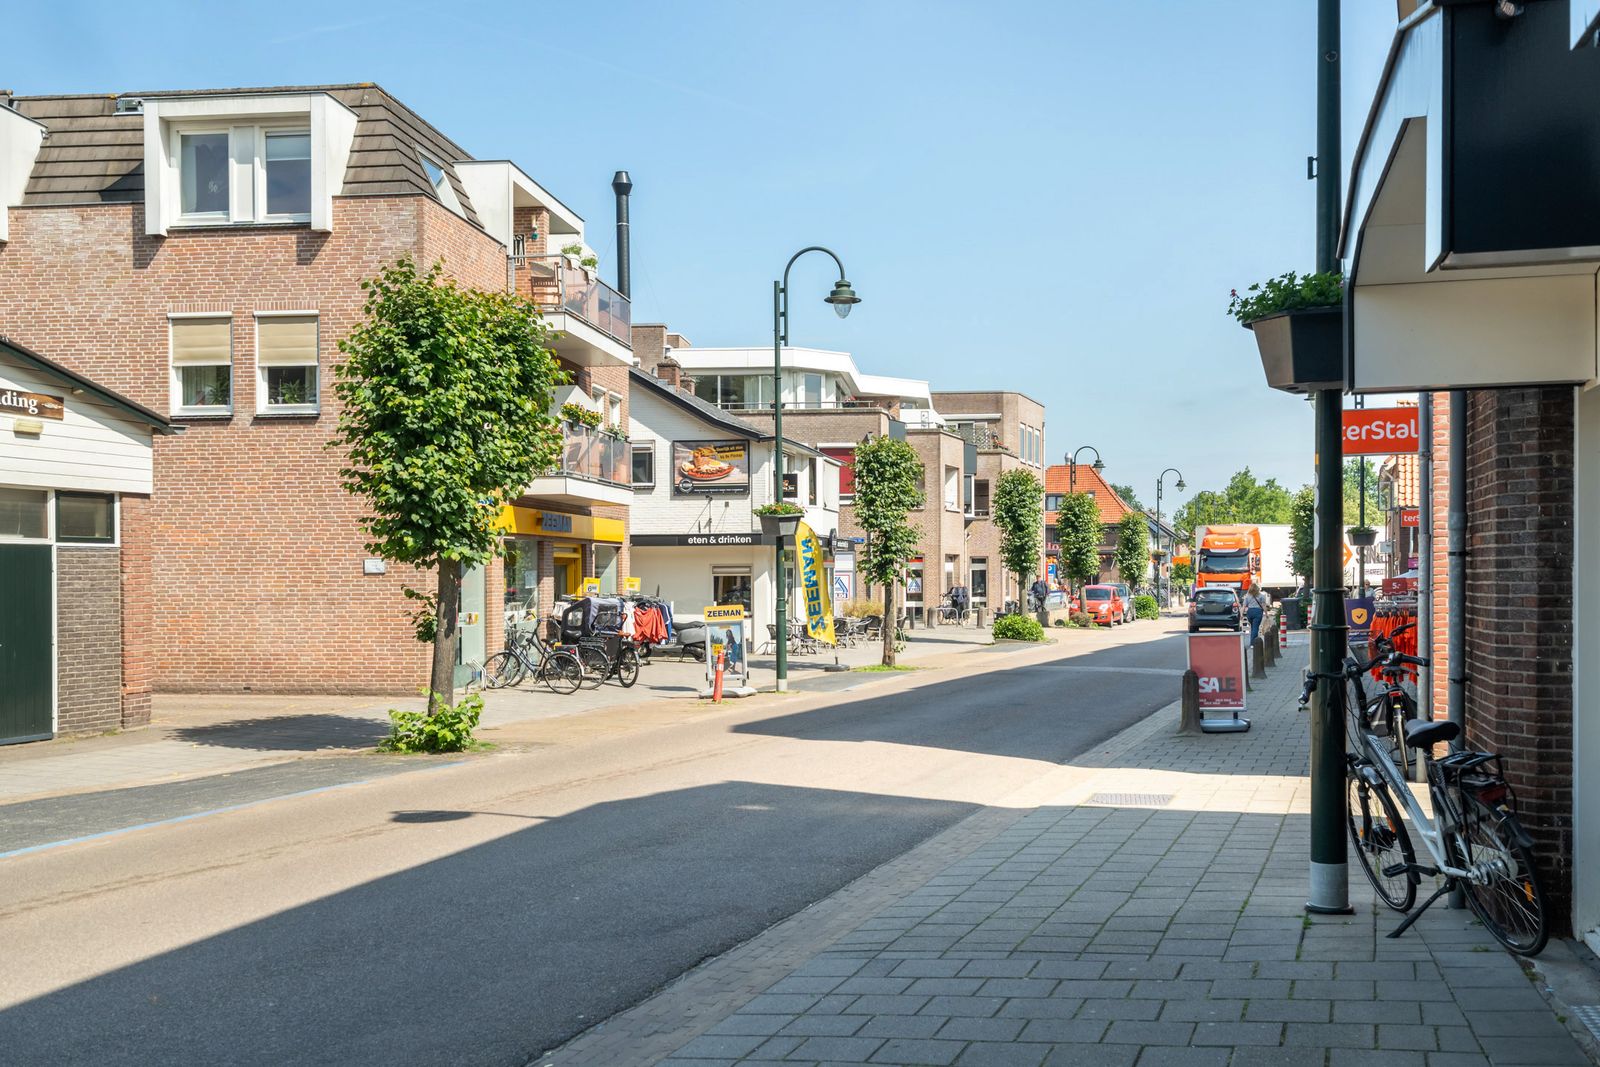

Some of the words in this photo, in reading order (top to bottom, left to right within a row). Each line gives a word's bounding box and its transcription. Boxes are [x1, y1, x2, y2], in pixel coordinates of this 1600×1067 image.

[0, 391, 38, 415] ding
[688, 536, 707, 545] eten
[709, 536, 716, 544] &
[717, 534, 752, 544] drinken
[801, 538, 828, 633] ZEEMAN
[707, 609, 741, 618] ZEEMAN
[1199, 676, 1236, 693] SALE
